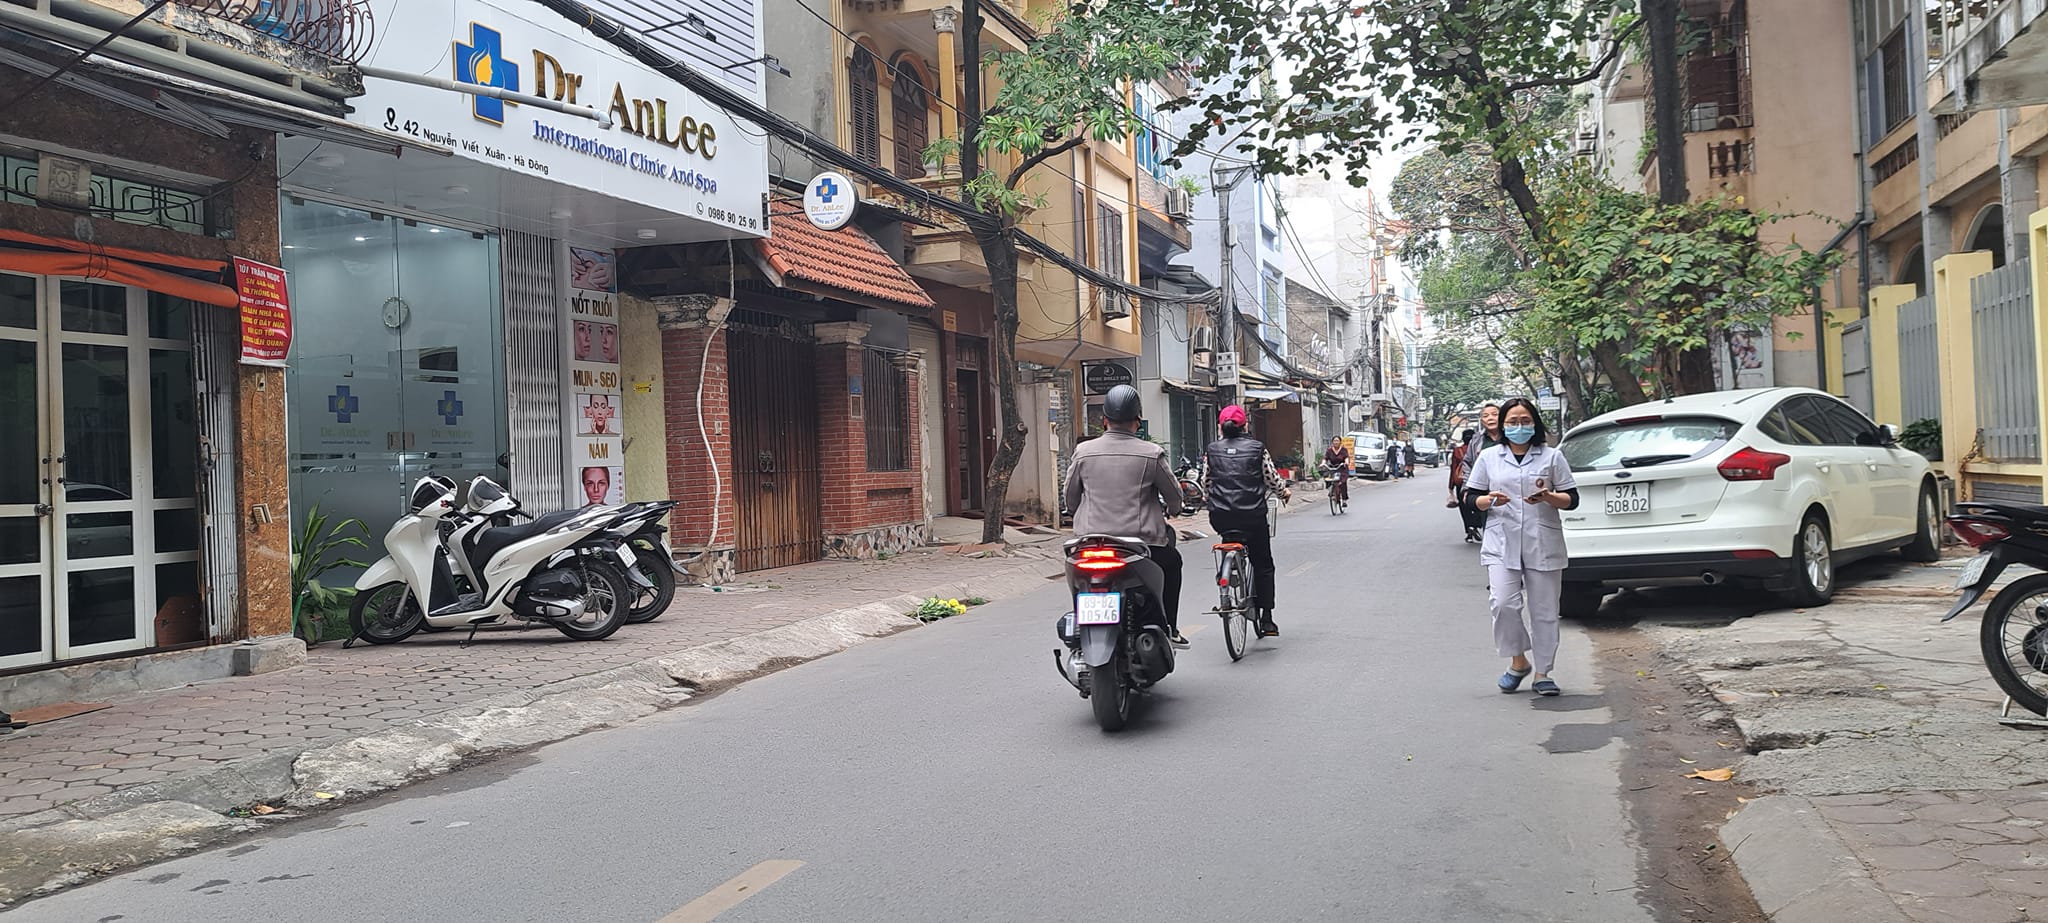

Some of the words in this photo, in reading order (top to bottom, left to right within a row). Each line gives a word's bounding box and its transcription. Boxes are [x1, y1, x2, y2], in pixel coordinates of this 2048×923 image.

[609, 81, 718, 160] AnLee
[403, 119, 420, 137] 42
[423, 128, 457, 148] Nguyễn
[461, 139, 480, 154] Viết
[484, 145, 506, 161] Xuân
[514, 154, 525, 167] Hà
[528, 158, 549, 175] Đông
[532, 119, 627, 165] International
[629, 151, 667, 177] Clinic
[670, 166, 694, 187] And
[694, 172, 718, 194] Spa
[707, 206, 726, 223] 0986
[727, 212, 736, 224] 90
[738, 215, 747, 228] 25
[748, 217, 757, 229] 90
[571, 290, 591, 315] NỐT
[573, 369, 593, 392] MỤN
[600, 370, 617, 393] SẸO
[588, 438, 609, 459] NÁM
[1615, 485, 1637, 498] 37A
[1607, 498, 1647, 513] 508.02
